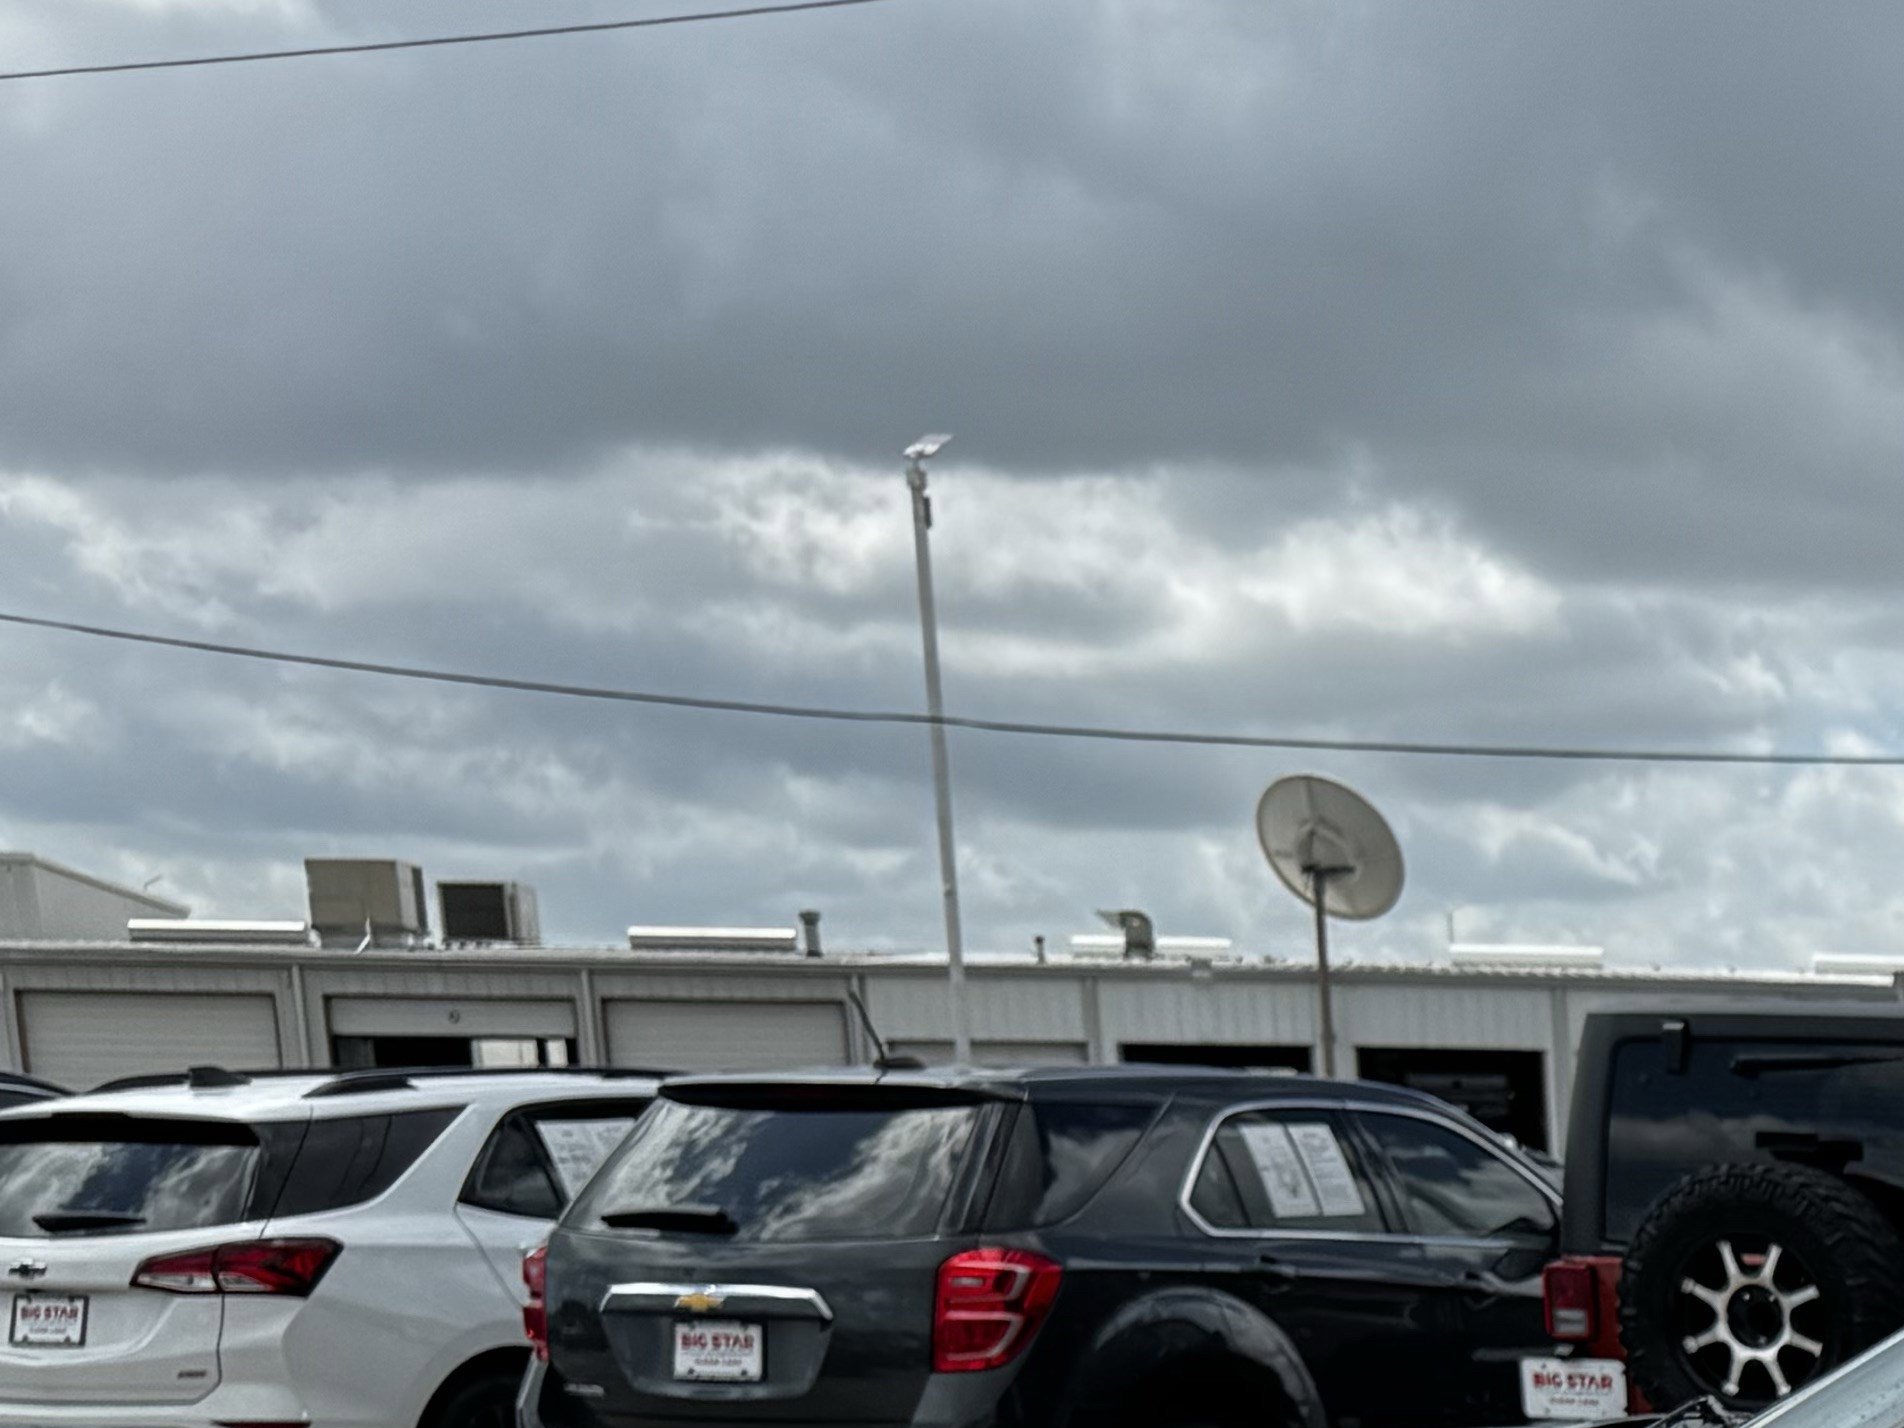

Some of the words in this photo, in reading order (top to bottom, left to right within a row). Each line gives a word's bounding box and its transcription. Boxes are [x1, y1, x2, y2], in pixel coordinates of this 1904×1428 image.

[682, 1332, 707, 1349] BIG
[711, 1332, 754, 1349] STAR
[1533, 1371, 1563, 1389] BIG
[1567, 1372, 1613, 1390] STAR
